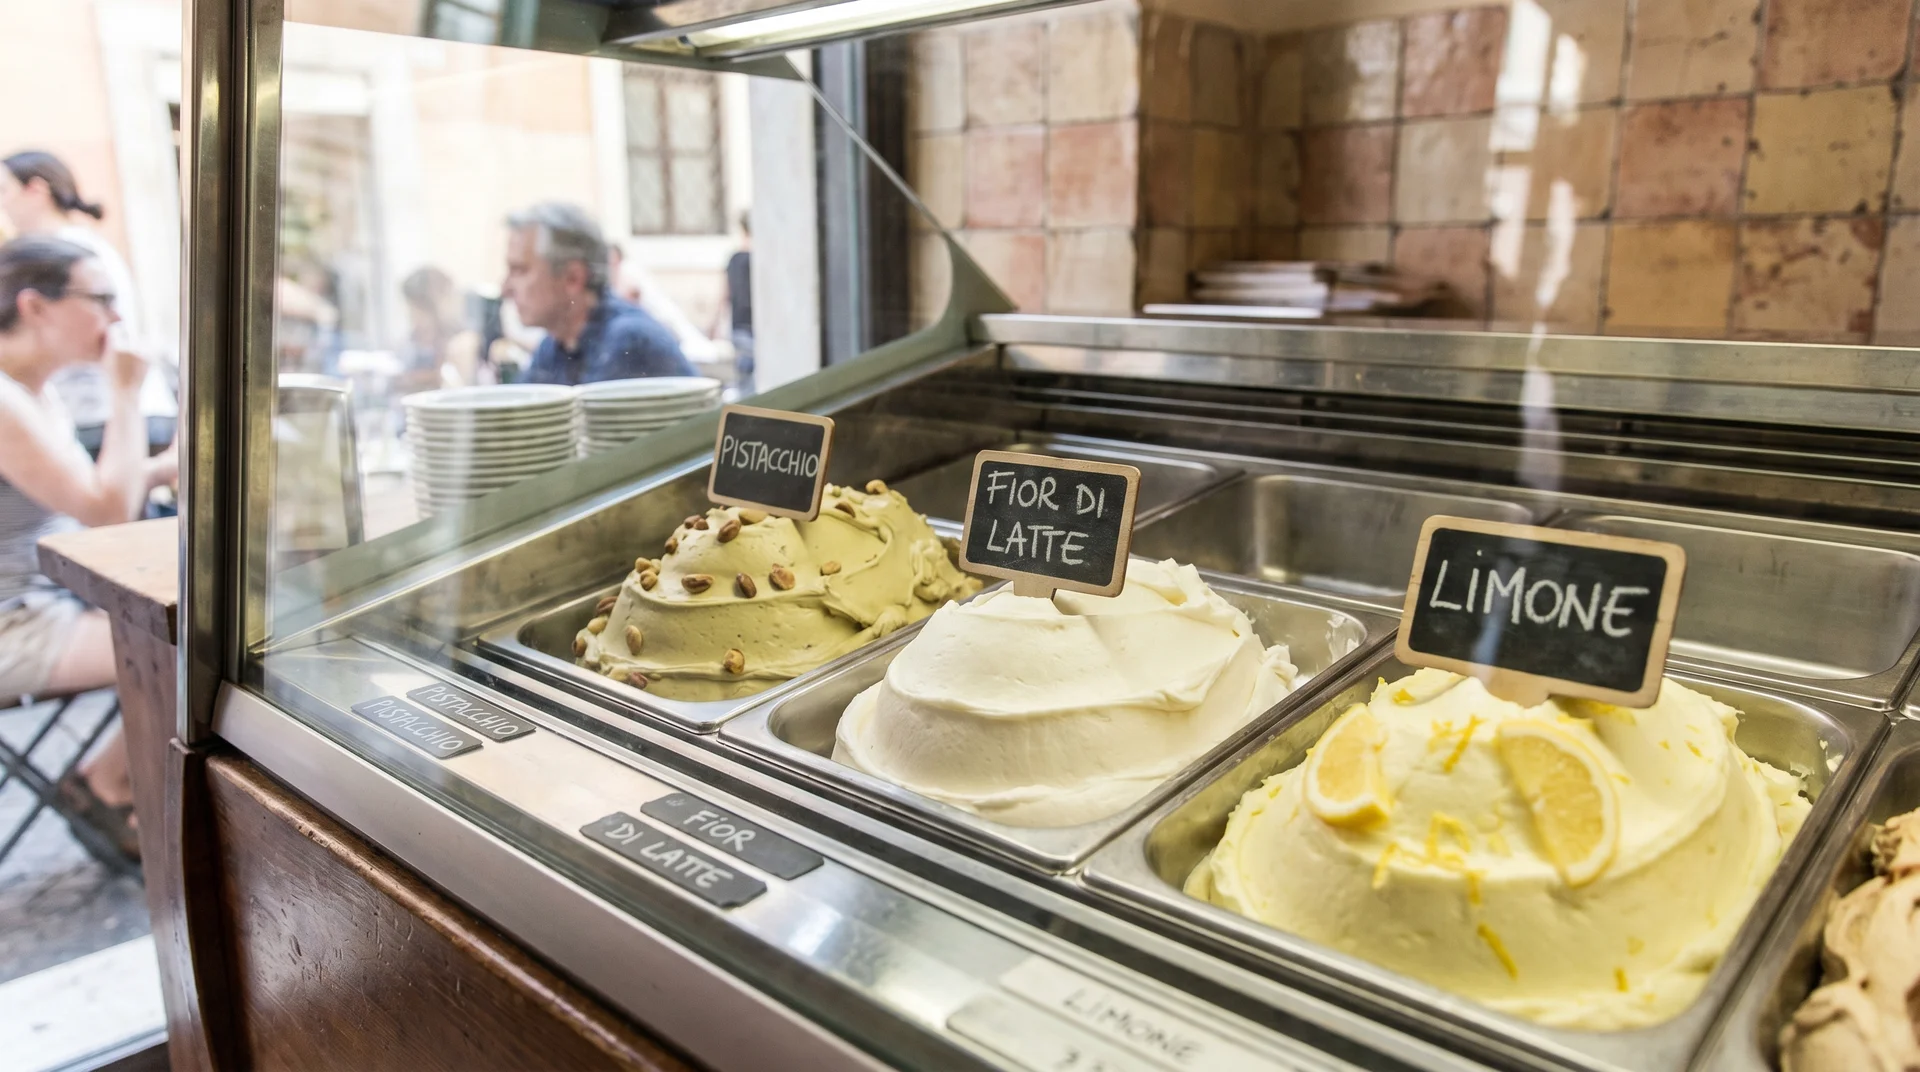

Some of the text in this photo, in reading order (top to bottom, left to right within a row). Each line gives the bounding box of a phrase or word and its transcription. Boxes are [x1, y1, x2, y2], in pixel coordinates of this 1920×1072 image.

[720, 434, 819, 478] PISTACCHIO
[986, 470, 1105, 518] FIOR DI
[986, 519, 1089, 566] LATTE
[362, 699, 463, 750] PISTACCHIO
[416, 686, 518, 735] PISTACCHIO
[604, 822, 734, 888] DI LATTE
